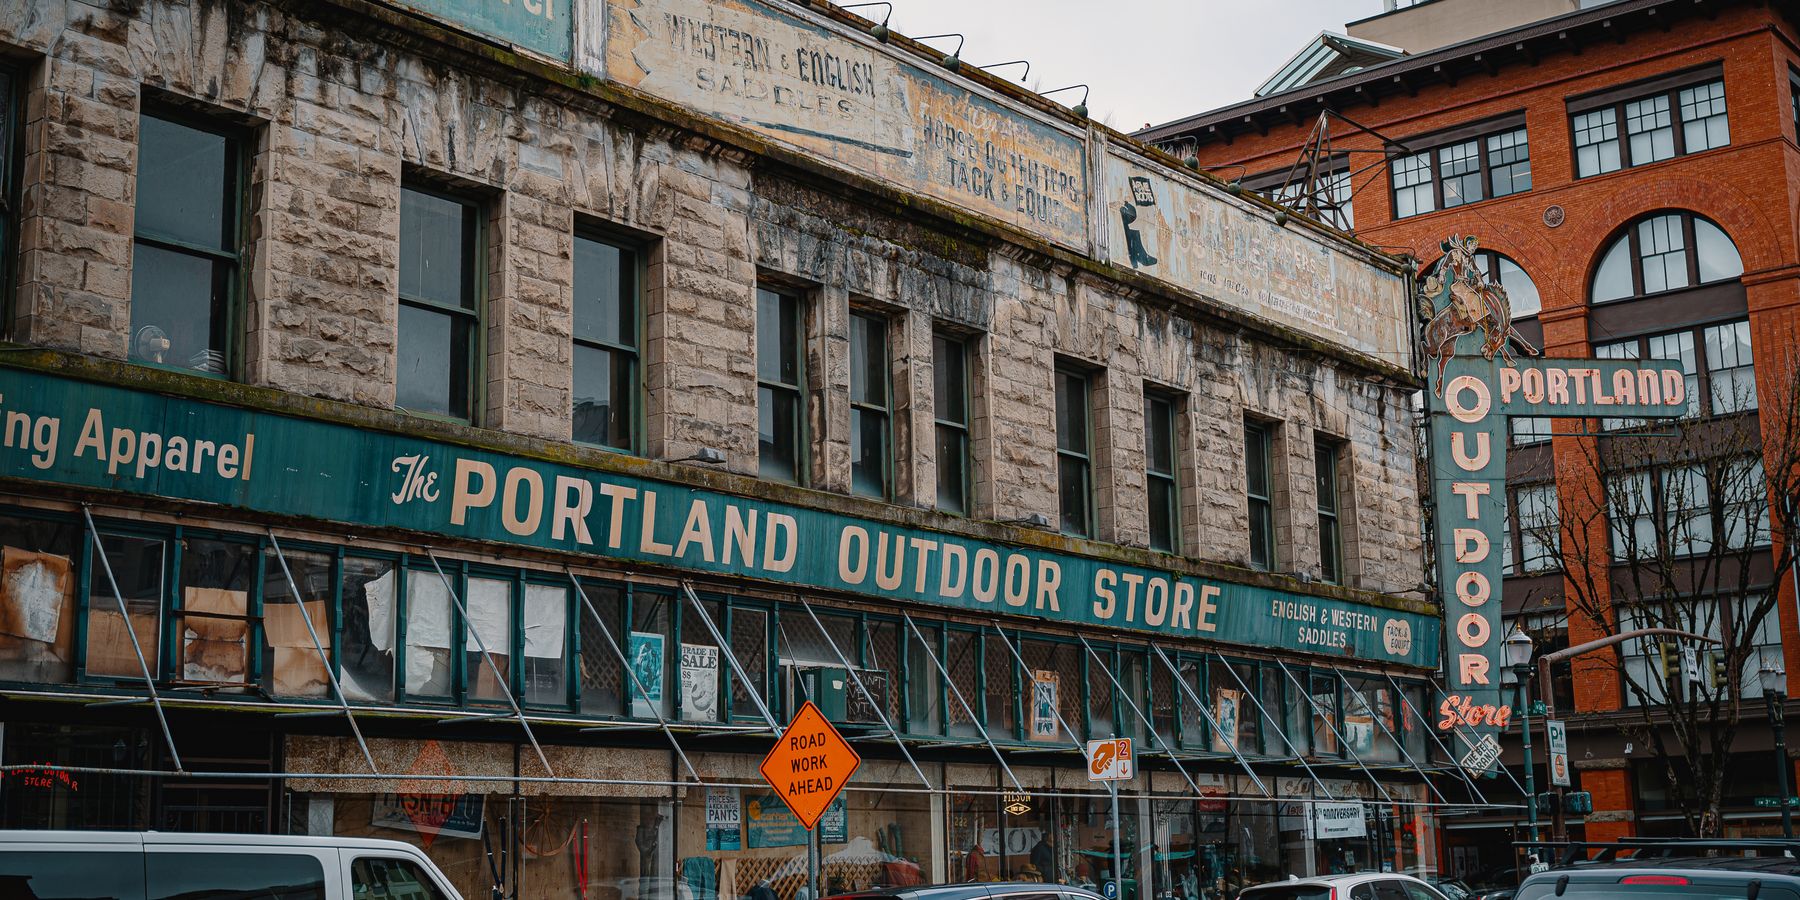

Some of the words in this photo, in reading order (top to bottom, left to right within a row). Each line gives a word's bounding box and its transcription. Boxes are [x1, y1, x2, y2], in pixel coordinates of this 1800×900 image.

[796, 47, 876, 98] ENGLISH
[947, 156, 995, 201] TACK
[1500, 367, 1685, 405] PORTLAND
[0, 398, 60, 470] ng
[74, 408, 255, 481] Apparel
[1445, 375, 1491, 685] OUTDOOR
[391, 453, 440, 505] The
[450, 458, 798, 573] PORTLAND
[838, 525, 1061, 612] OUTDOOR
[1094, 568, 1221, 632] STORE
[1272, 600, 1316, 622] ENGLISH
[1321, 608, 1328, 625] &
[1331, 608, 1378, 632] WESTERN
[1298, 626, 1347, 649] SADDLES
[683, 646, 706, 655] TRADE
[682, 654, 717, 669] SALE
[1439, 695, 1512, 730] Store
[790, 732, 826, 751] ROAD
[1119, 741, 1128, 756] 2
[791, 754, 827, 773] WORK
[1463, 752, 1479, 768] THE
[788, 776, 833, 796] AHEAD
[708, 795, 730, 804] PRICES
[708, 809, 738, 821] PANTS
[1108, 884, 1115, 897] P
